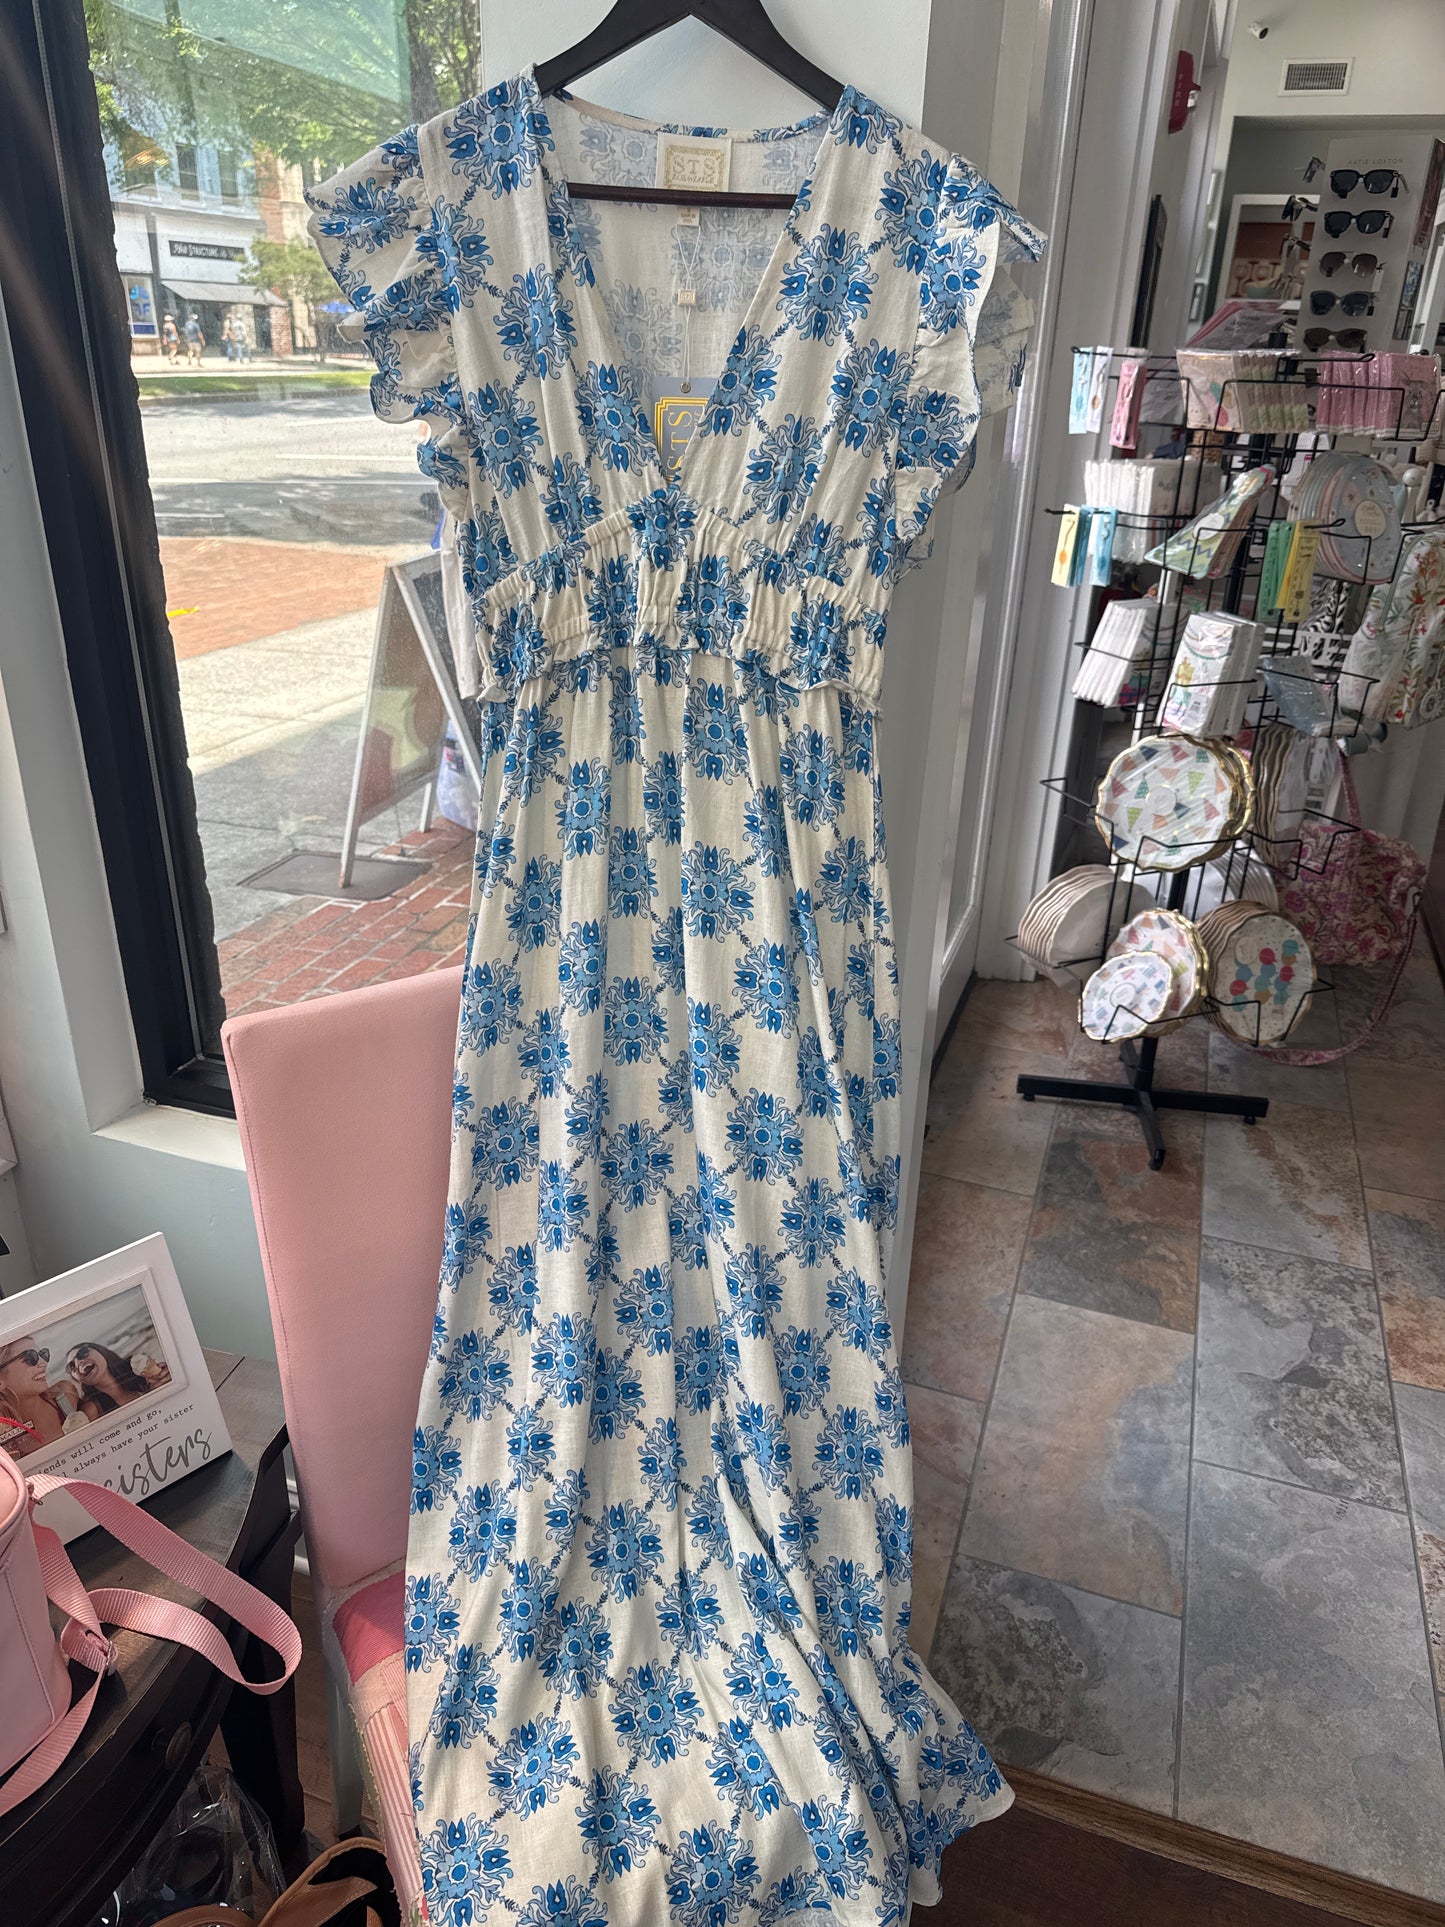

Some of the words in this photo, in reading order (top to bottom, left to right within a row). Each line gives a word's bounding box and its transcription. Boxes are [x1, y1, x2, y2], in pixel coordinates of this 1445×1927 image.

[672, 155, 716, 177] STS
[70, 1442, 95, 1460] will
[99, 1429, 121, 1445] come
[126, 1416, 142, 1431] and
[146, 1409, 162, 1421] go,
[73, 1451, 107, 1473] always
[111, 1437, 133, 1453] have
[137, 1423, 159, 1441] your
[163, 1403, 194, 1425] sister
